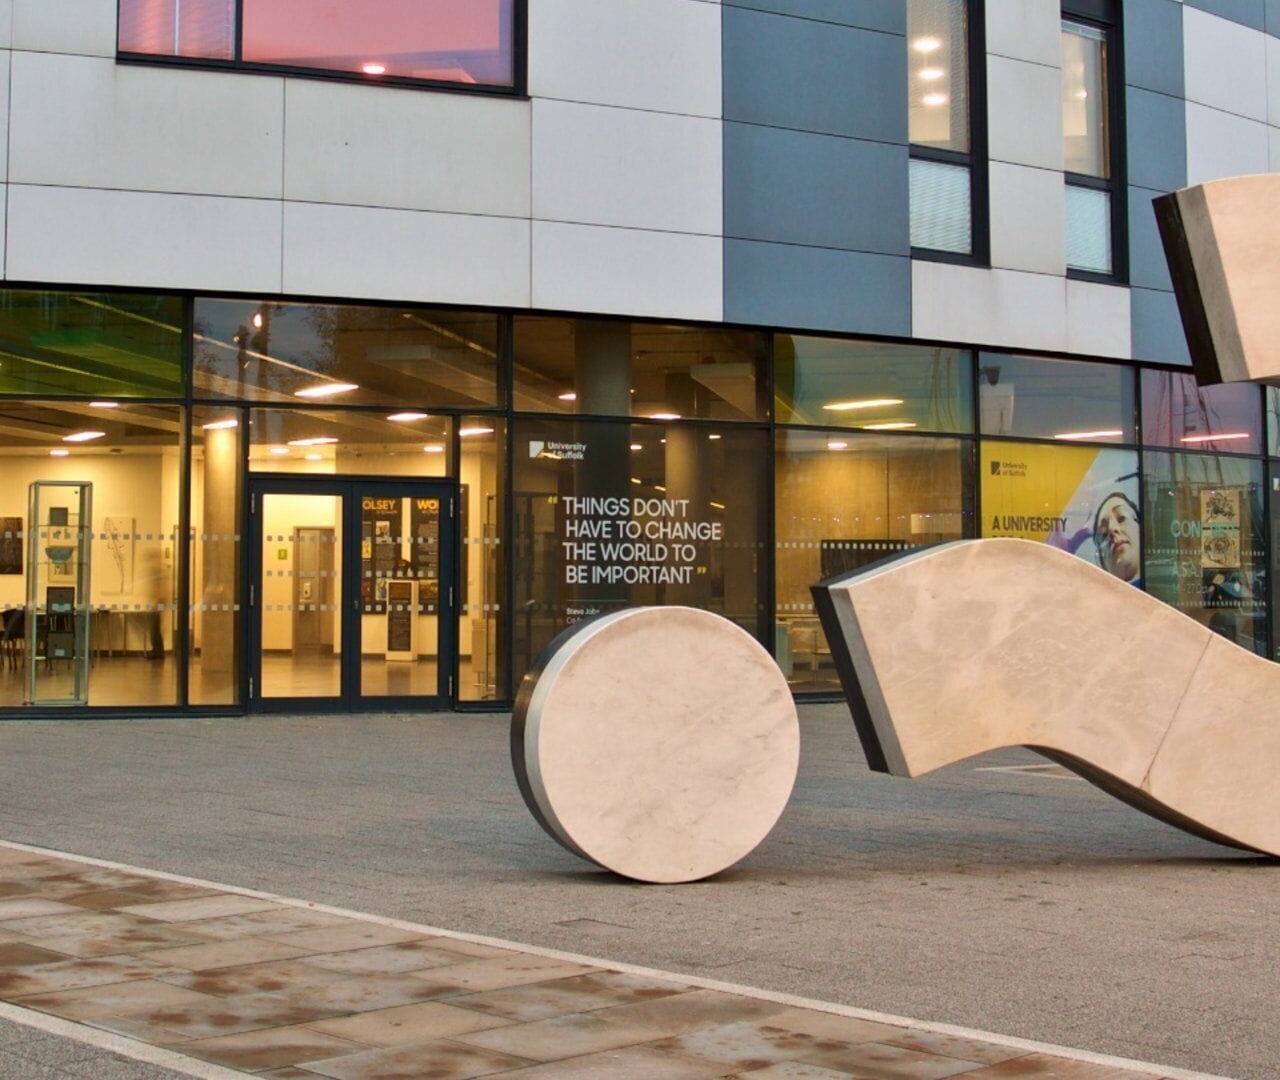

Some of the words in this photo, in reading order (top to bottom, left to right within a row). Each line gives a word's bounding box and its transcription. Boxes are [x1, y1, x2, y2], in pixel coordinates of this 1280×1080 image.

[547, 441, 587, 452] University
[362, 499, 396, 510] OLSEY
[562, 496, 630, 516] THINGS
[634, 498, 690, 517] DON'T
[565, 520, 612, 539] HAVE
[616, 520, 641, 539] TO
[645, 521, 722, 540] CHANGE
[992, 515, 1000, 530] A
[1003, 516, 1068, 532] UNIVERSITY
[562, 542, 597, 561] THE
[600, 543, 668, 562] WORLD
[671, 544, 696, 562] TO
[565, 565, 588, 584] BE
[592, 566, 694, 584] IMPORTANT
